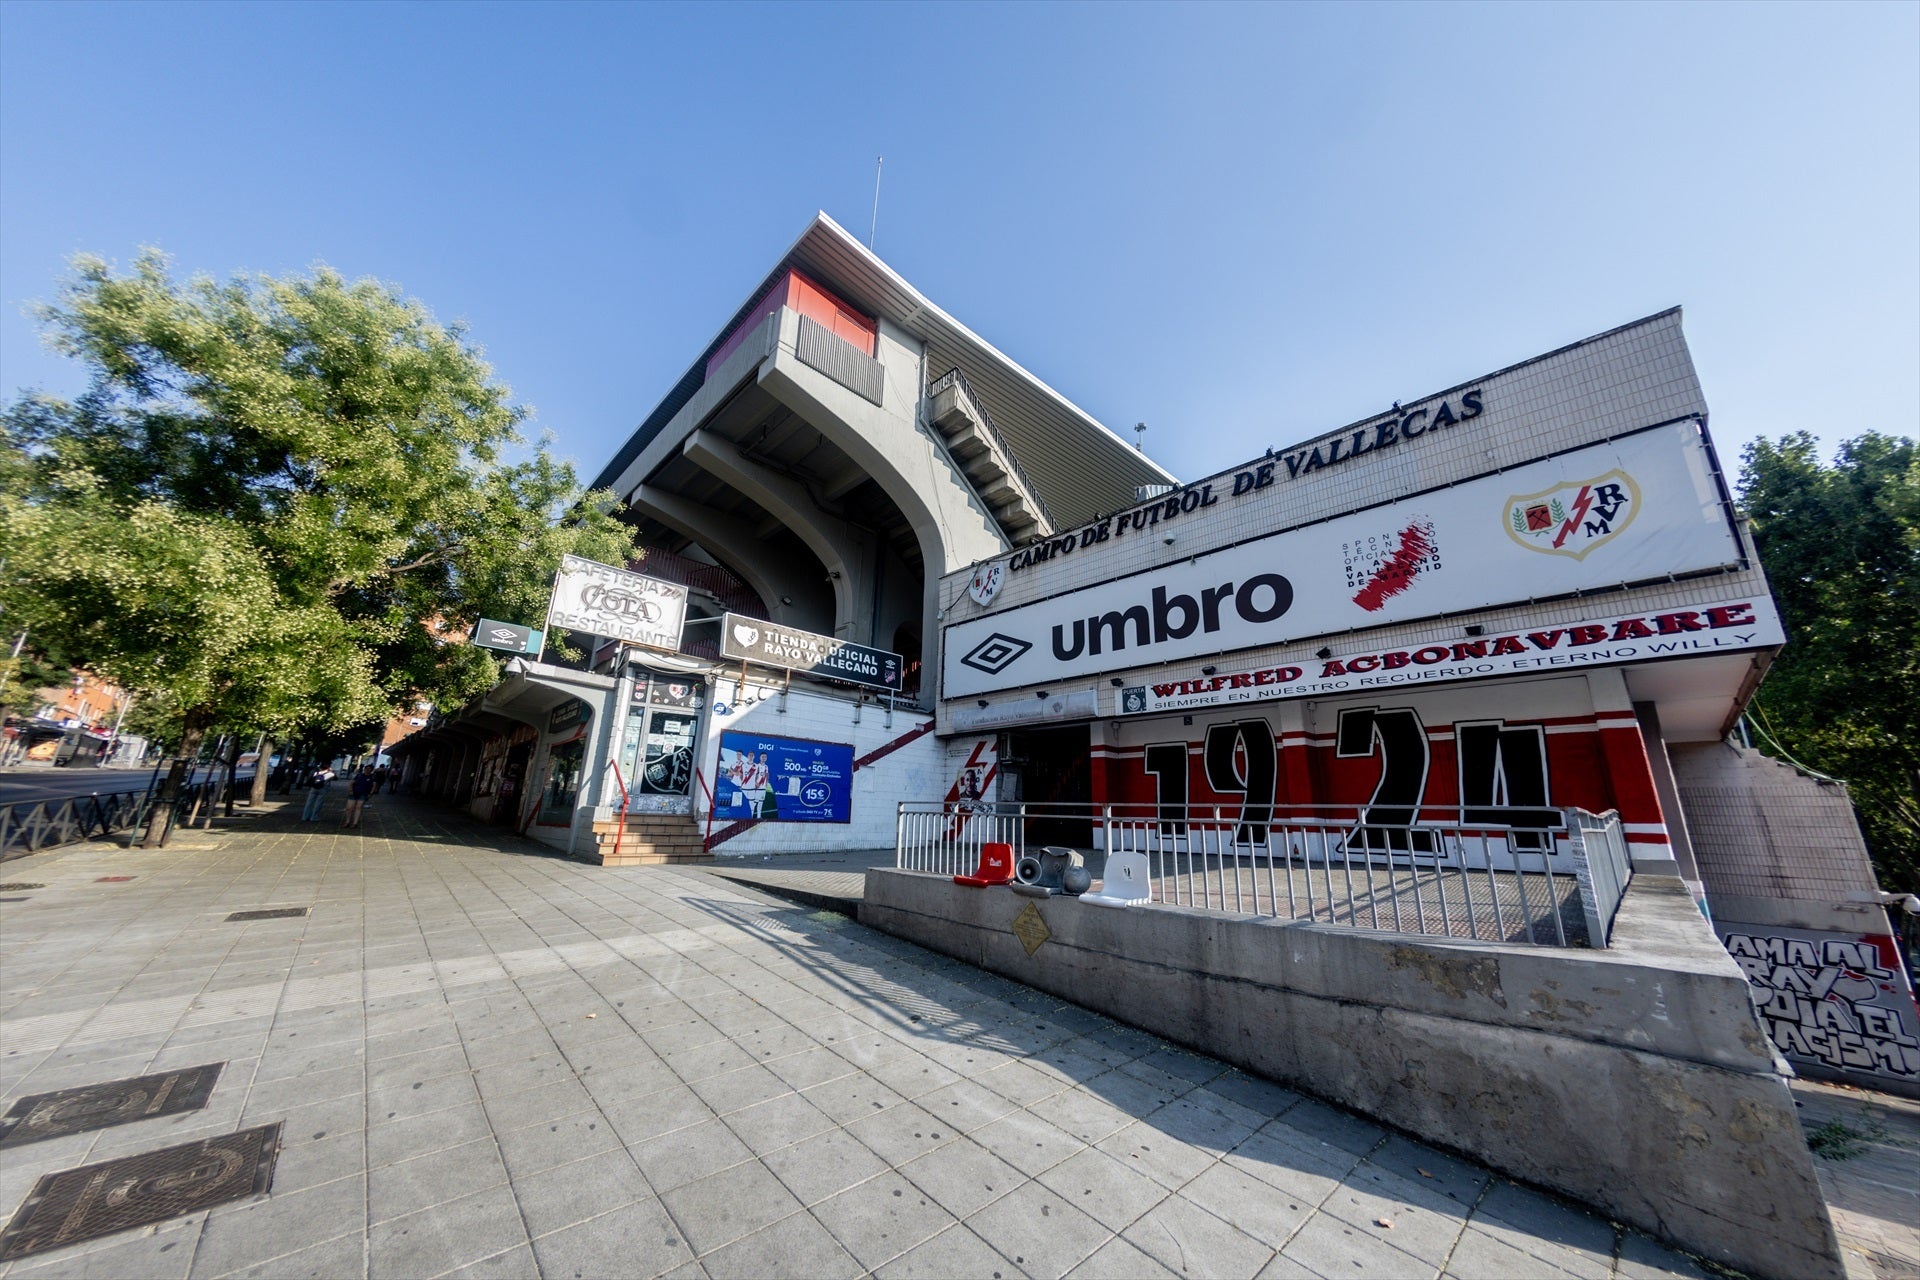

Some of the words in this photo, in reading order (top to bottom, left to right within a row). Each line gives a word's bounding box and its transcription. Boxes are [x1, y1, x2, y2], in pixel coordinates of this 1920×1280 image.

[1008, 534, 1077, 572] CAMPO
[1080, 518, 1111, 548] DE
[1114, 485, 1219, 537] FUTBOL
[1232, 461, 1276, 497] DE
[1283, 388, 1485, 480] VALLECAS
[1344, 548, 1396, 565] OFICIAL
[1348, 578, 1366, 588] DE
[552, 611, 678, 648] RESTAURANTE
[1051, 573, 1294, 661] umbro
[491, 637, 514, 646] umbro
[764, 642, 802, 659] RAYO
[805, 651, 878, 676] VALLECANO
[765, 630, 818, 652] TIENDA
[829, 646, 879, 665] OFICIAL
[1150, 665, 1304, 698] WILFRED
[1320, 602, 1758, 680] AGBONAVBARE
[1153, 695, 1220, 710] SIEMPRE
[1228, 691, 1252, 701] EN
[1258, 681, 1350, 699] NUESTRO
[1361, 664, 1495, 686] RECUERDO
[1512, 647, 1637, 669] ETERNO
[1647, 632, 1758, 653] WILLY
[1122, 686, 1146, 695] PUERTA
[758, 742, 774, 751] DIGI
[784, 762, 801, 772] 500
[812, 764, 823, 774] 50
[1144, 705, 1567, 859] 1924
[806, 788, 824, 799] 15€
[1726, 935, 1819, 966] AMA
[1823, 941, 1893, 979] AL
[1855, 1004, 1920, 1046] EL
